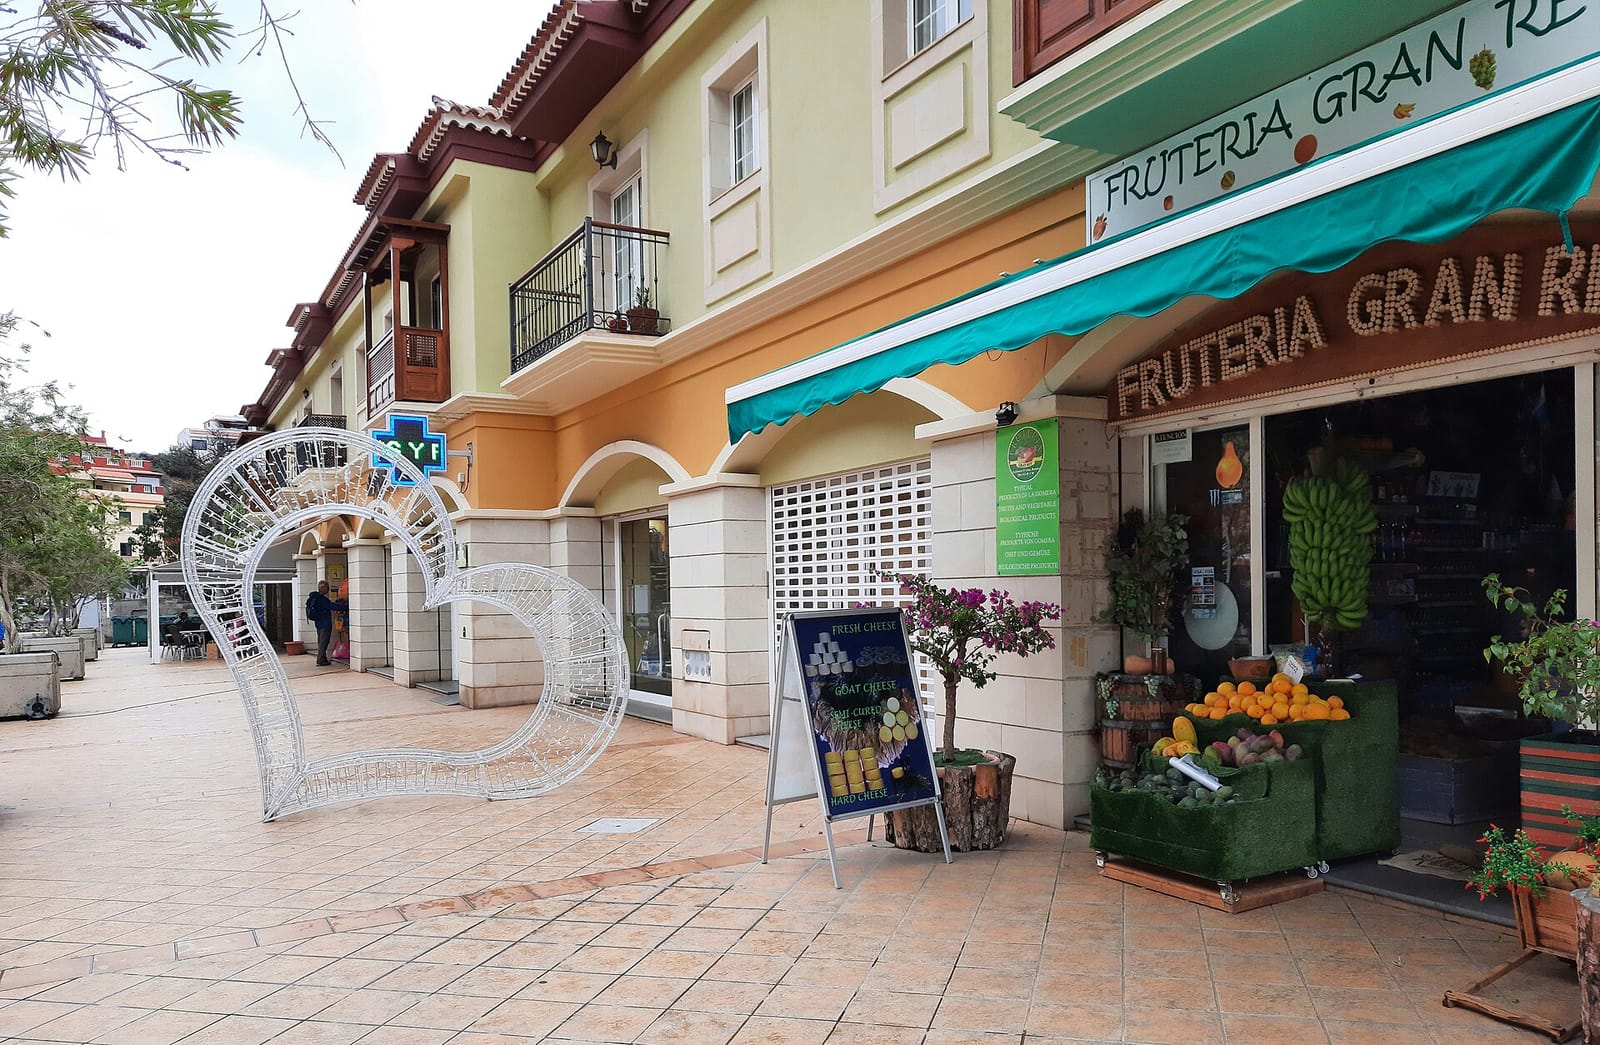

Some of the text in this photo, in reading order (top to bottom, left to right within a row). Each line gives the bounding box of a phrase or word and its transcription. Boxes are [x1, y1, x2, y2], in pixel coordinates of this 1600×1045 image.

[1104, 98, 1293, 212] FRUTERIA
[1312, 16, 1466, 125] GRAN
[1117, 295, 1328, 417] FRUTERIA
[1347, 252, 1523, 336] GRAN
[832, 621, 897, 636] FRESH CHEESE
[834, 680, 897, 696] GOAT CHEESE
[831, 788, 888, 806] HARD CHEESE
